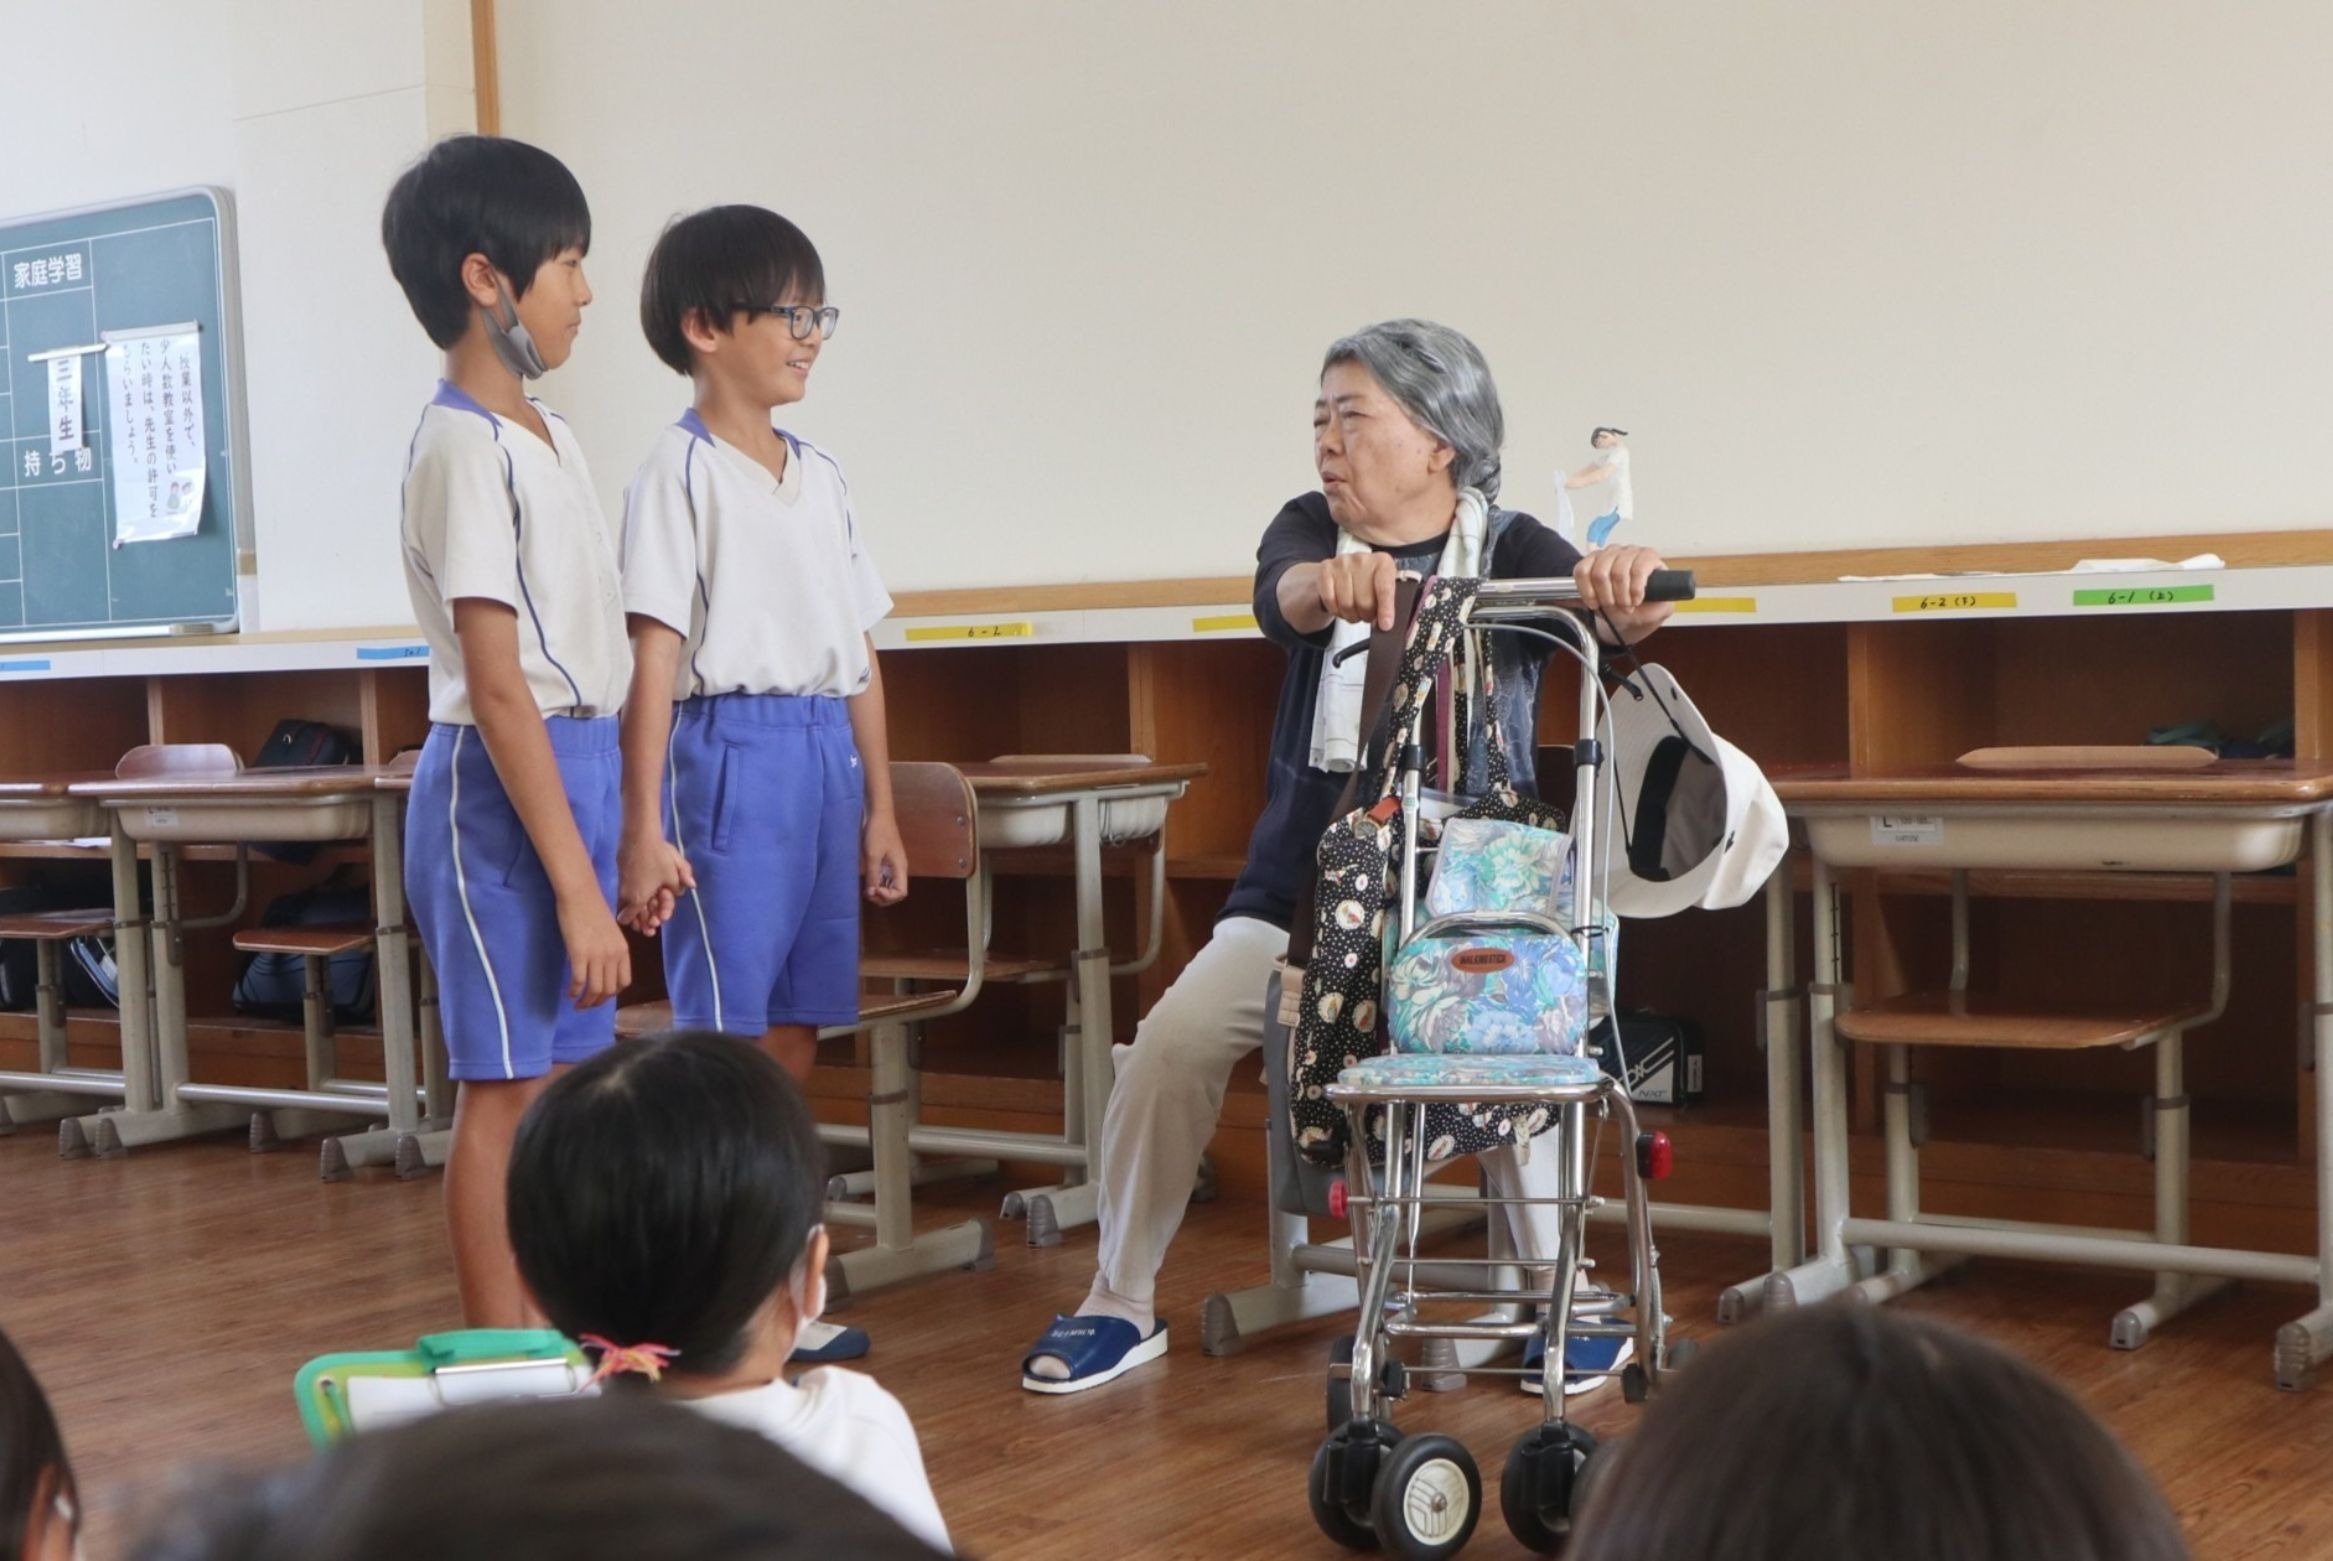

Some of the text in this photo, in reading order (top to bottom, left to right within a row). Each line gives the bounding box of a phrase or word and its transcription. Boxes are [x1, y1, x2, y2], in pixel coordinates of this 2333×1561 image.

[14, 252, 82, 289] 家庭学習
[56, 359, 75, 441] 三年生
[24, 447, 92, 477] 持ち物
